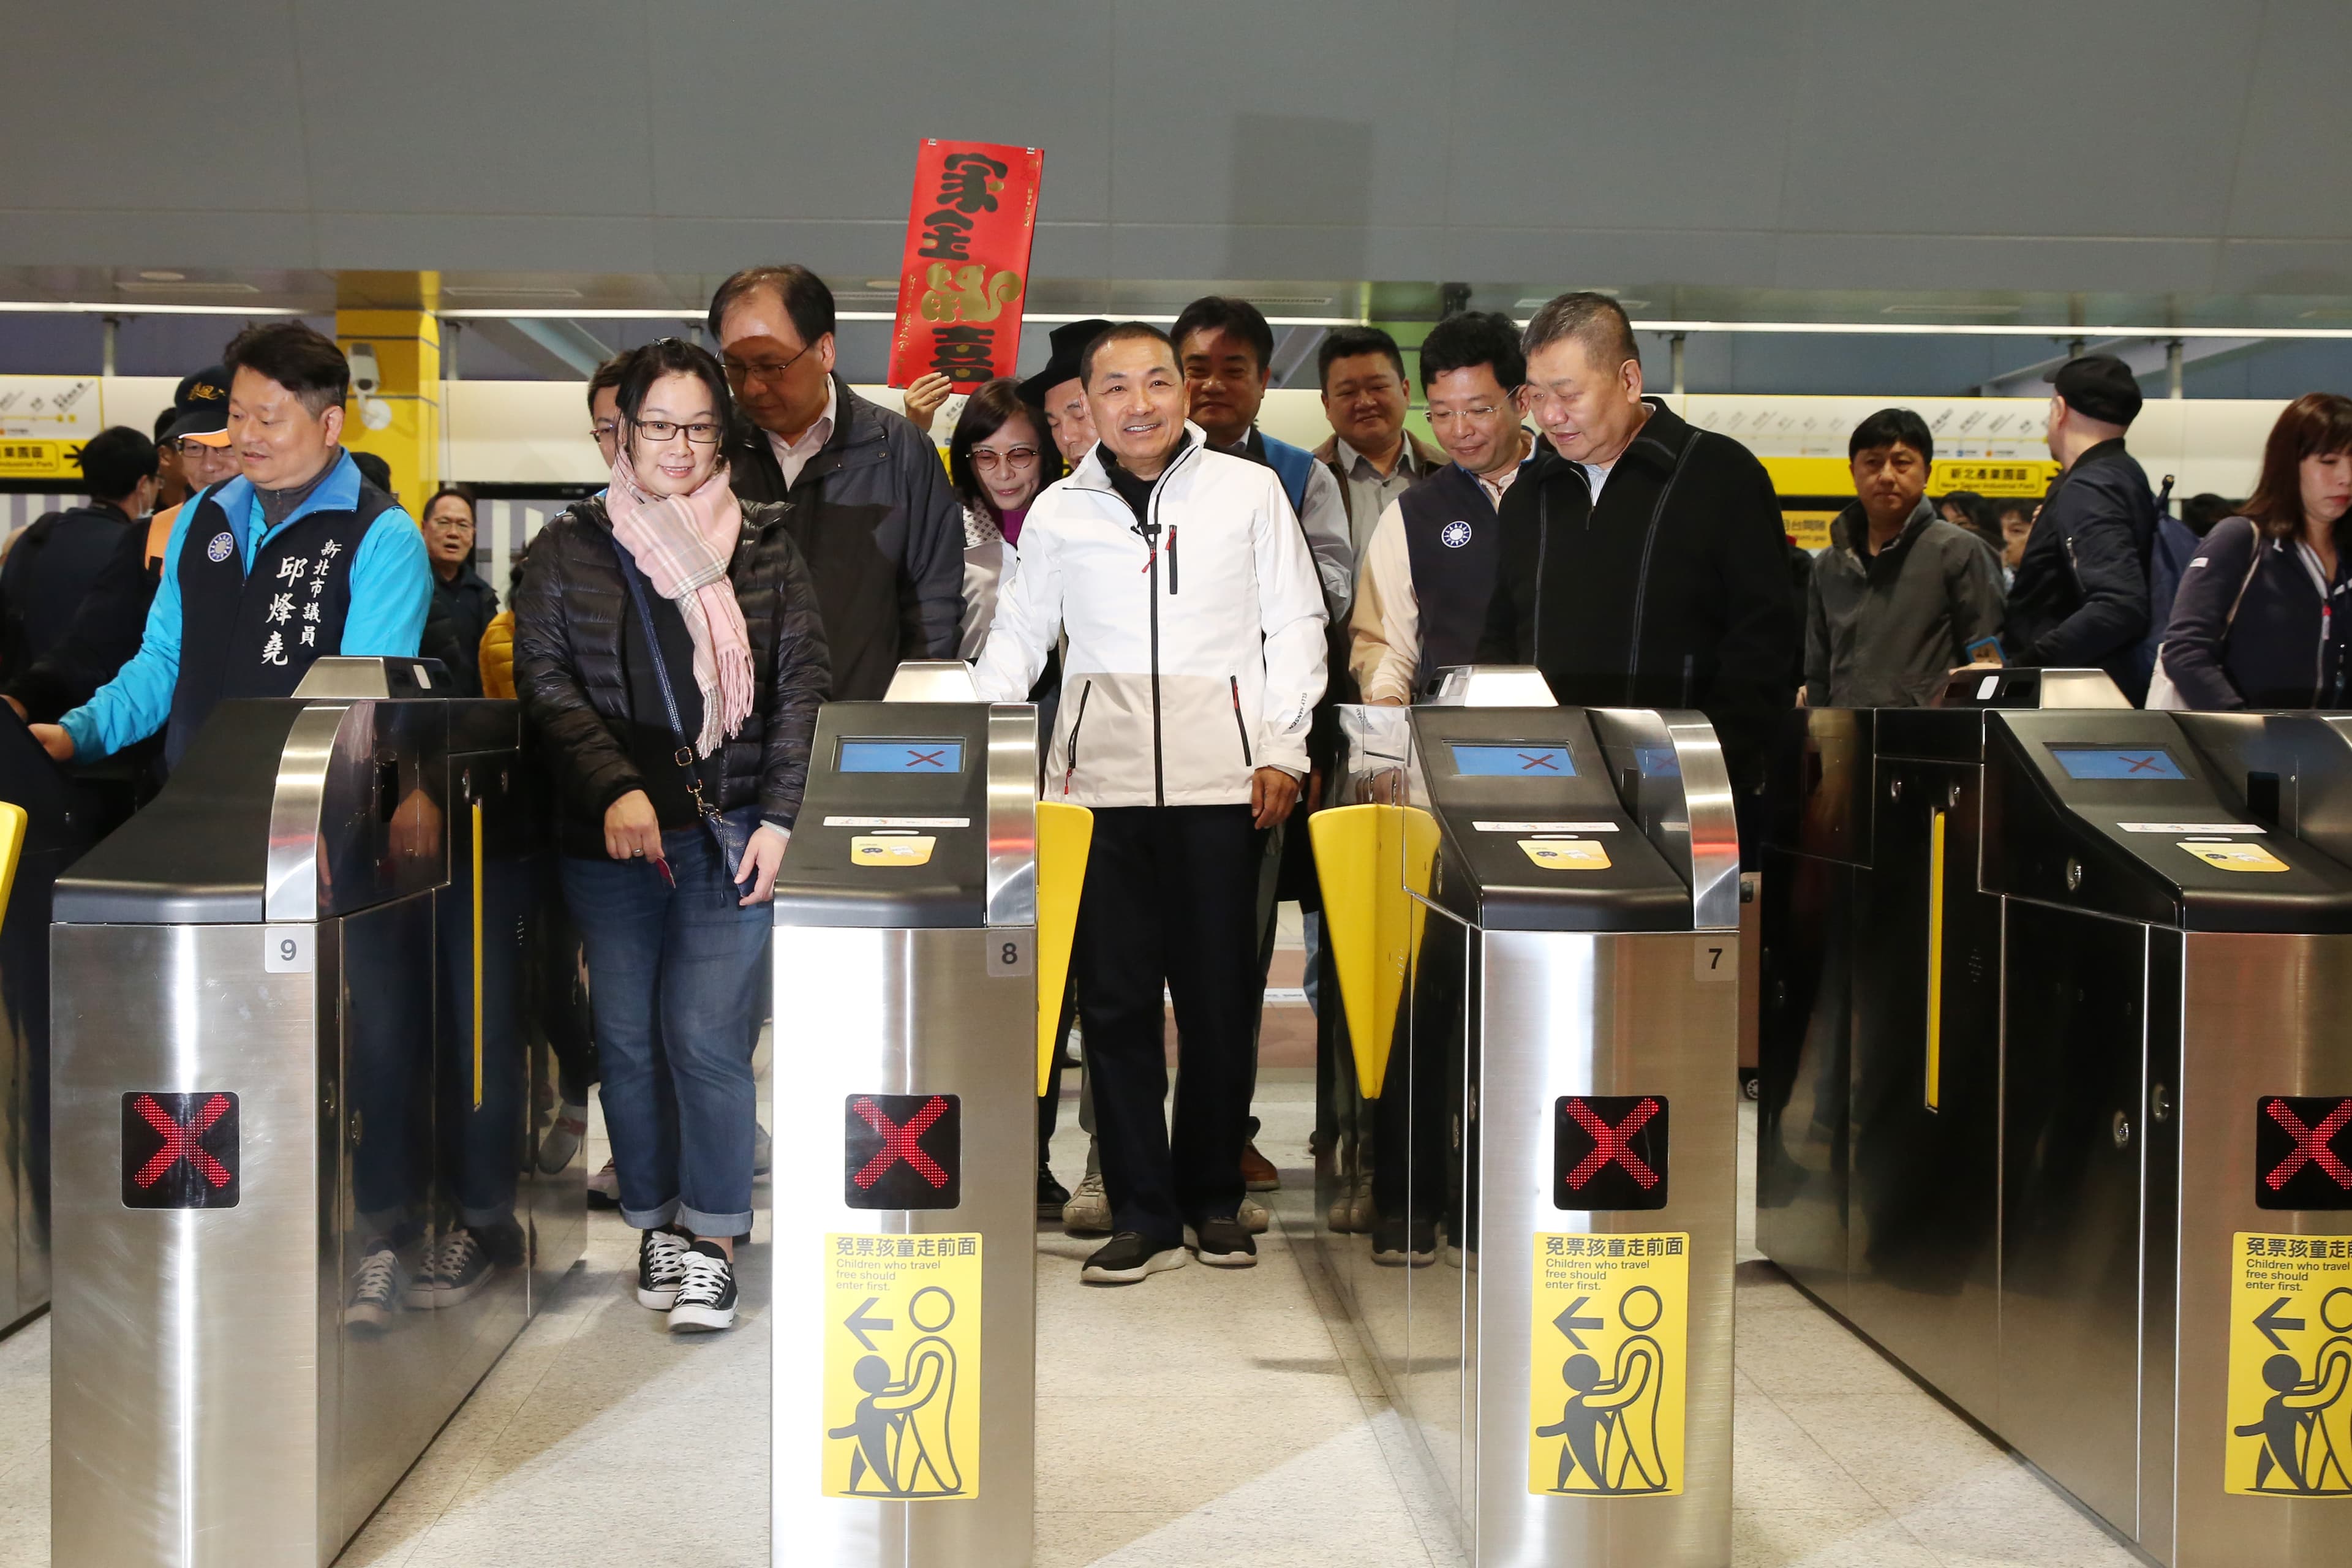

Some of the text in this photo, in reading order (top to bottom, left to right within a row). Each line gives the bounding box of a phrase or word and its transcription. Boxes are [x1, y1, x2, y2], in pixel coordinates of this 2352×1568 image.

[300, 538, 342, 647] 新北市議員
[261, 556, 308, 666] 邱烽堯
[280, 939, 297, 962] 9
[1001, 942, 1018, 965] 8
[1708, 948, 1723, 970] 7
[836, 1237, 976, 1257] 免票孩童走前面
[1545, 1236, 1683, 1257] 免票孩童走前面
[2246, 1237, 2352, 1259] 免票孩童走
[837, 1259, 941, 1270] Children who travel
[1546, 1259, 1649, 1269] Children who travel
[2247, 1259, 2350, 1271] Children who travel
[836, 1270, 895, 1280] free should
[1546, 1269, 1607, 1280] free should
[2246, 1269, 2309, 1281] free should
[836, 1281, 891, 1291] enter first.
[1545, 1281, 1601, 1291] enter first.
[2245, 1281, 2303, 1291] enter first.
